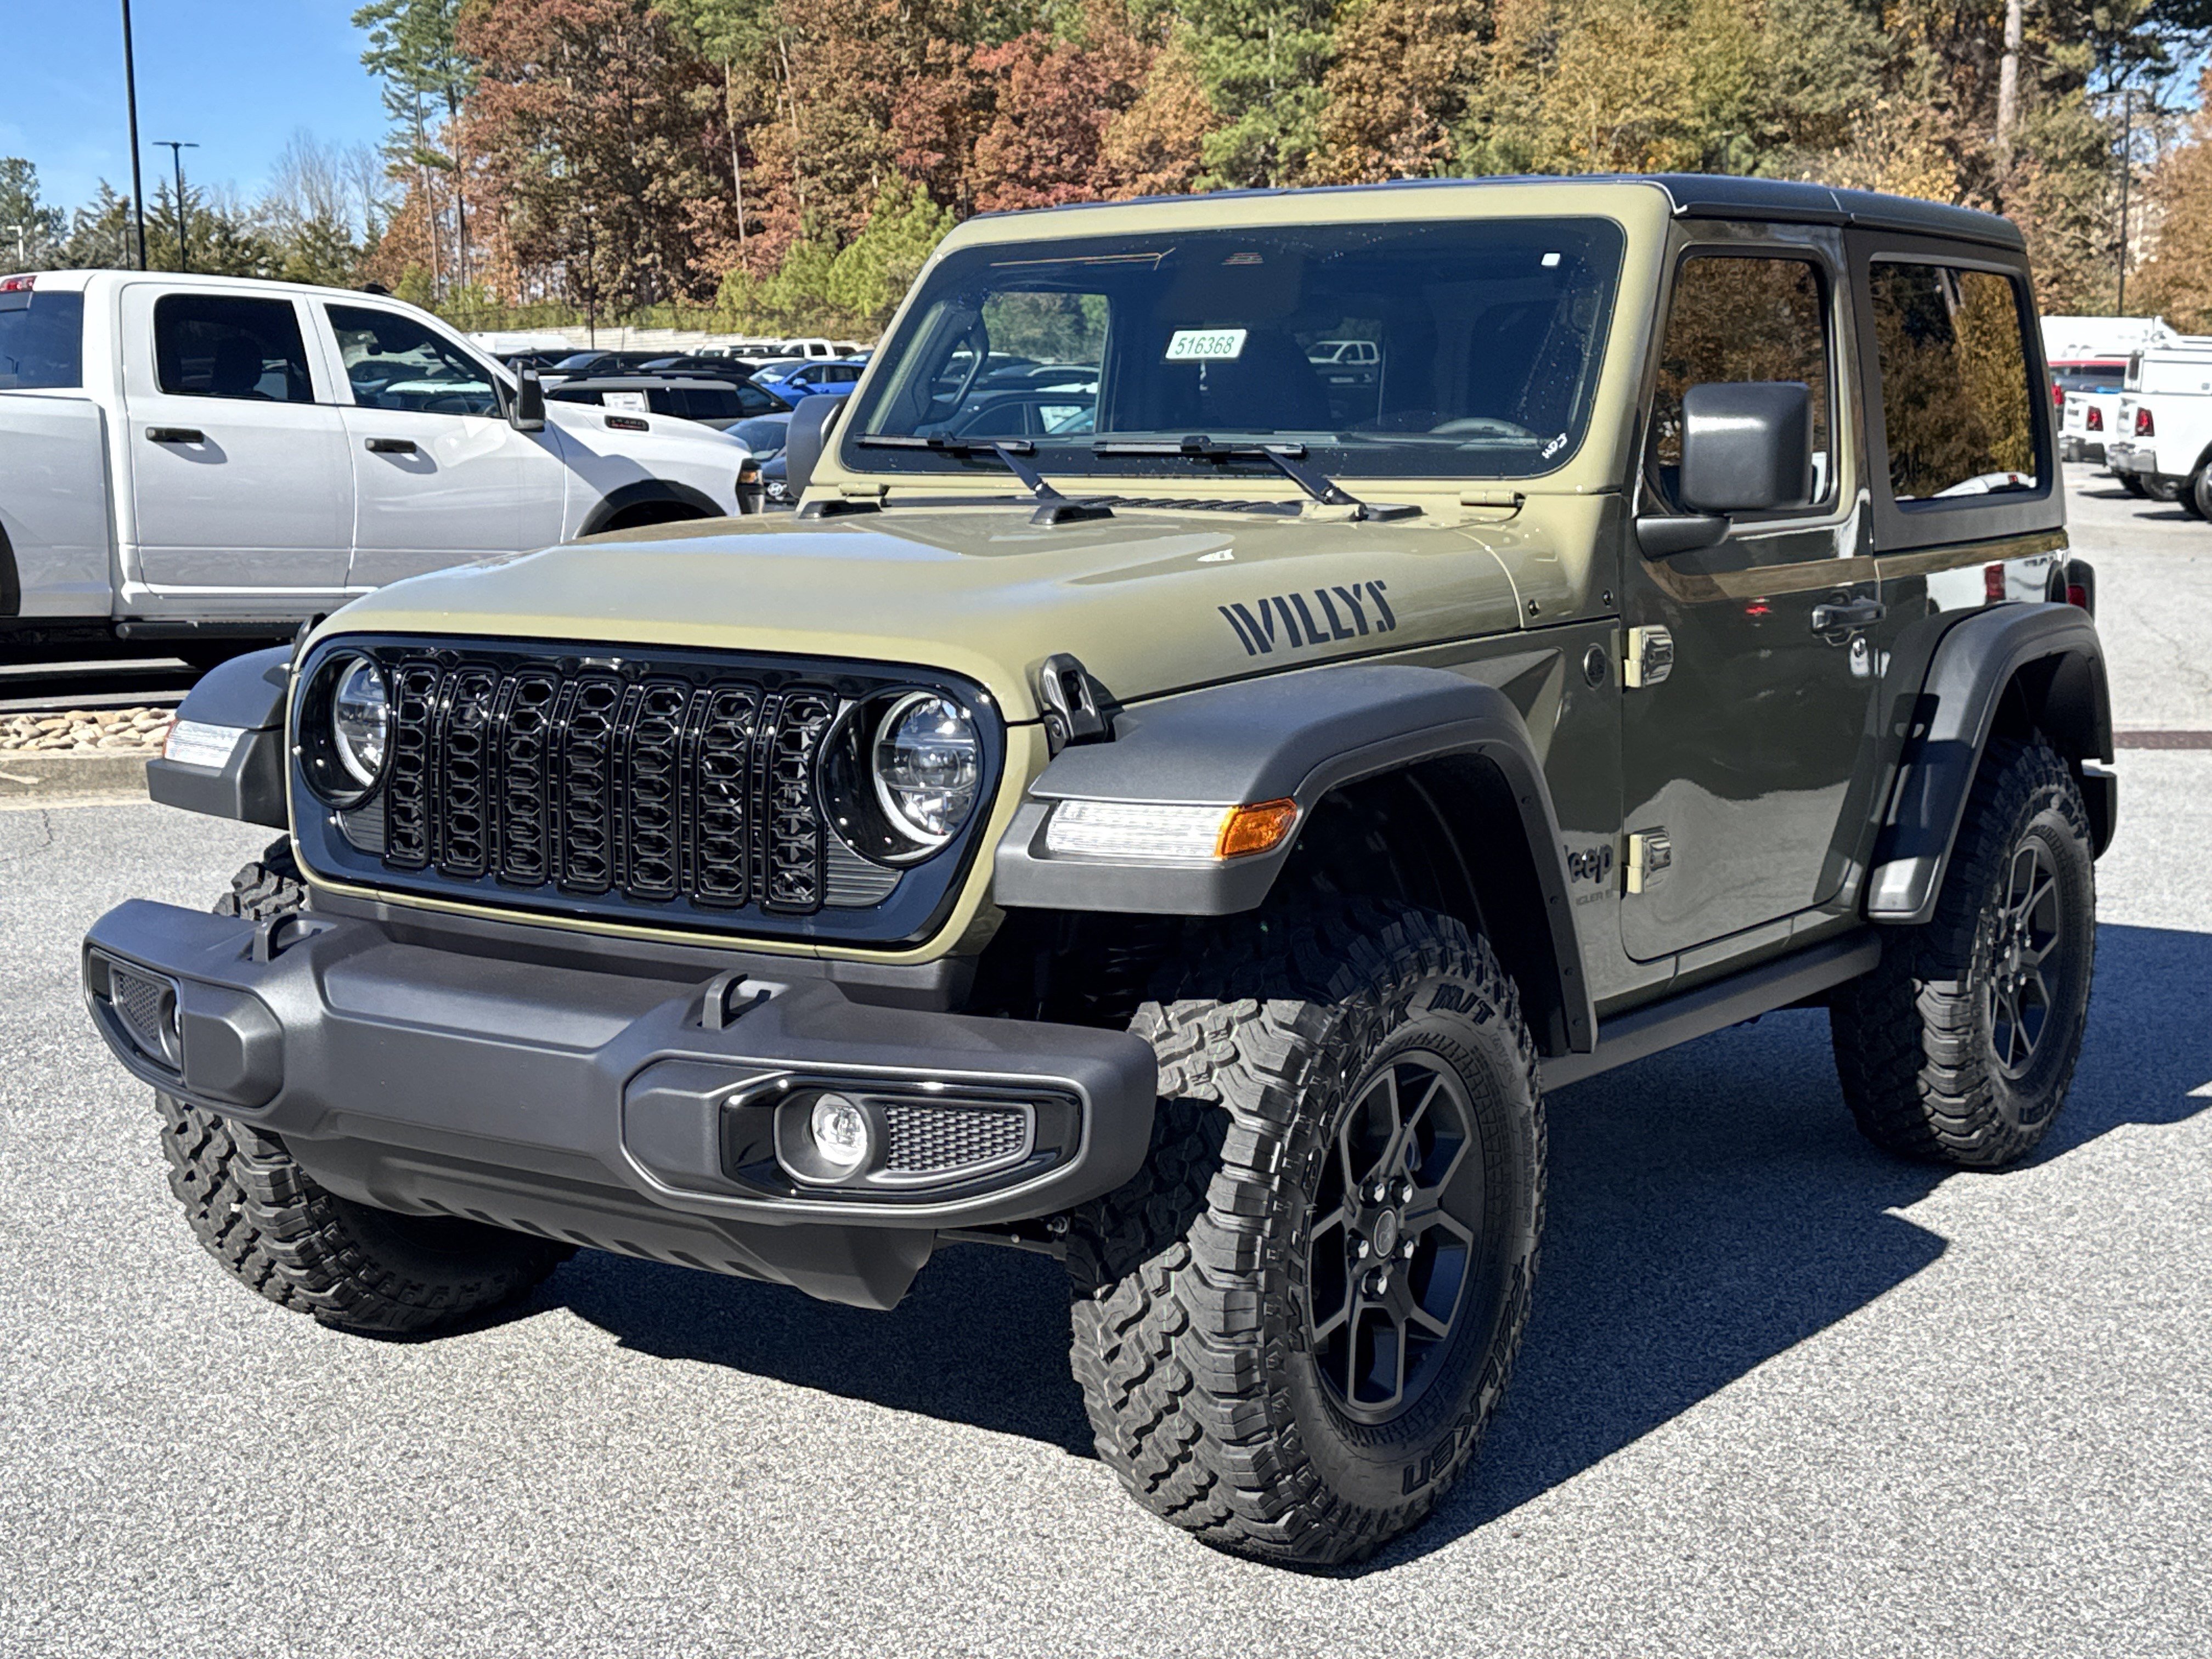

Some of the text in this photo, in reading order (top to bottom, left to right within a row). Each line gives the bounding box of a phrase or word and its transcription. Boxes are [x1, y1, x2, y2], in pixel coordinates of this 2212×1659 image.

[1174, 336, 1235, 355] 516368
[1217, 580, 1397, 656] WILLYS
[1564, 844, 1614, 884] eep
[1426, 983, 1496, 1026] M/T
